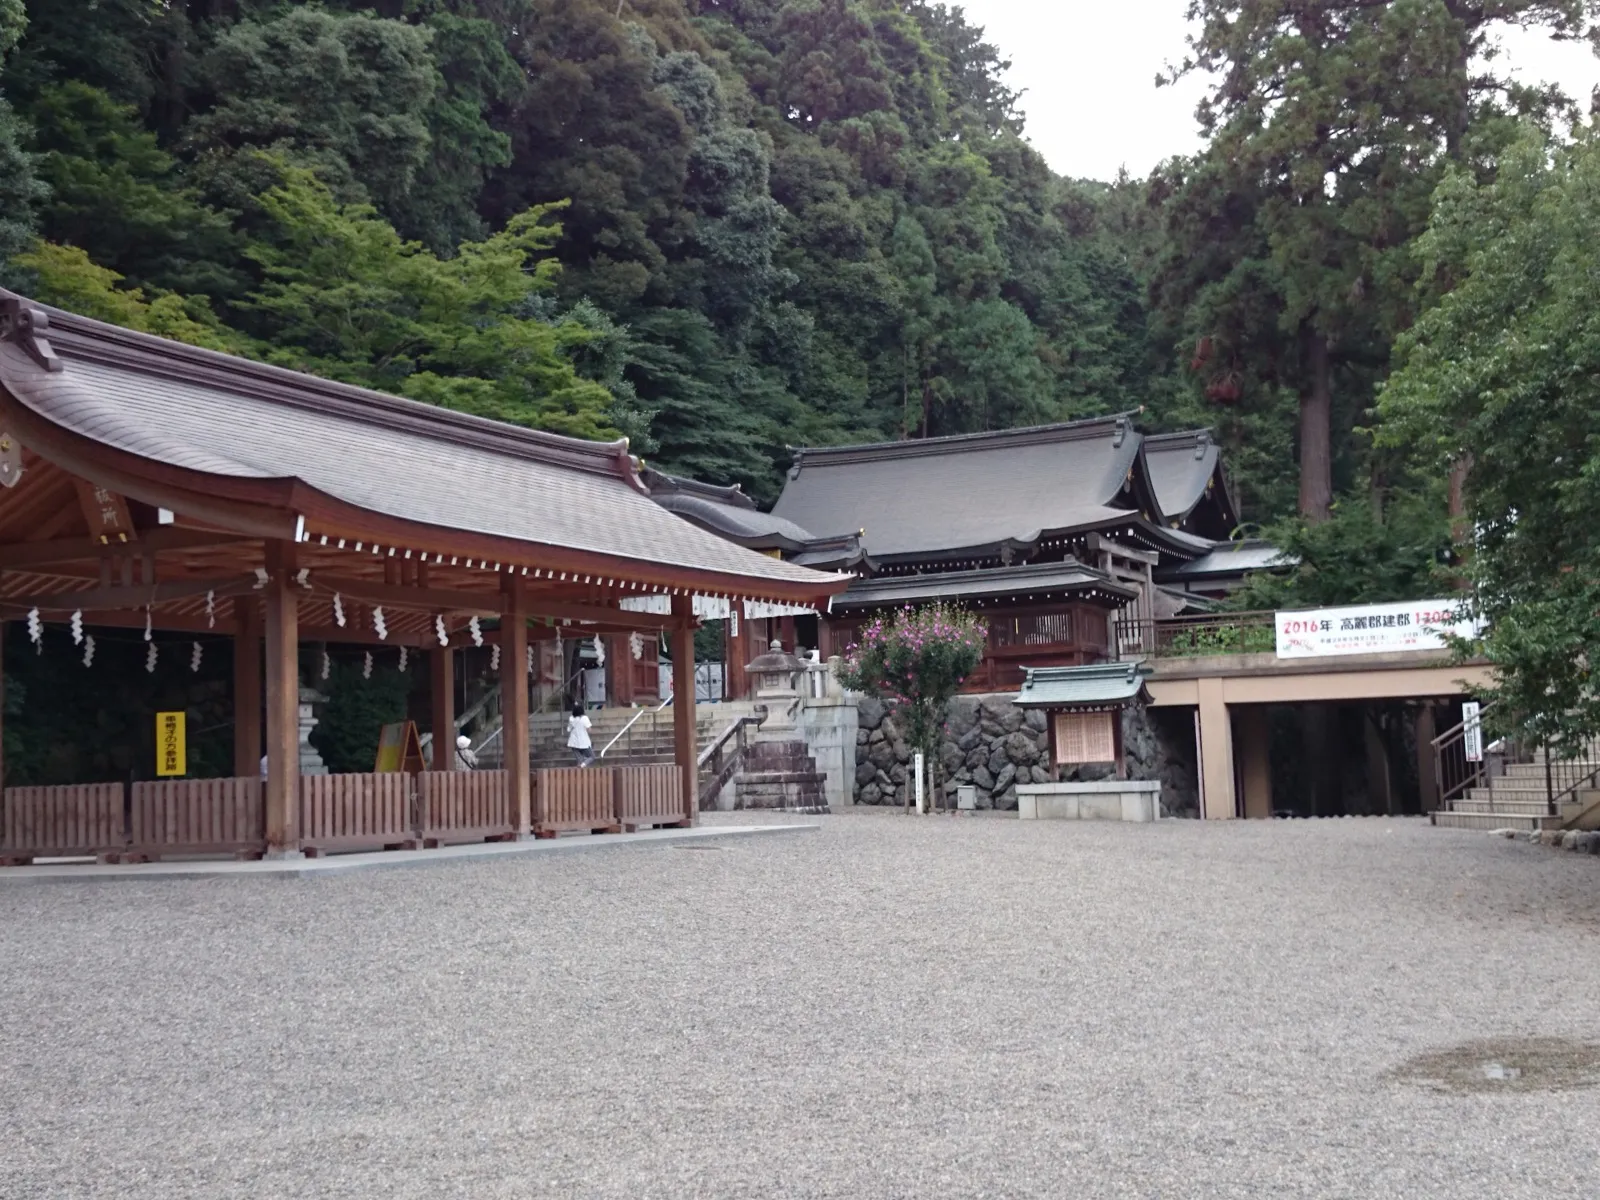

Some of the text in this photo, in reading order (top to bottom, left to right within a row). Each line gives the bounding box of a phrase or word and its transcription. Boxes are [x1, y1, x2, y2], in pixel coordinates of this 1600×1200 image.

[1284, 619, 1333, 634] 2016年
[1340, 613, 1410, 631] 高麗郡建郡
